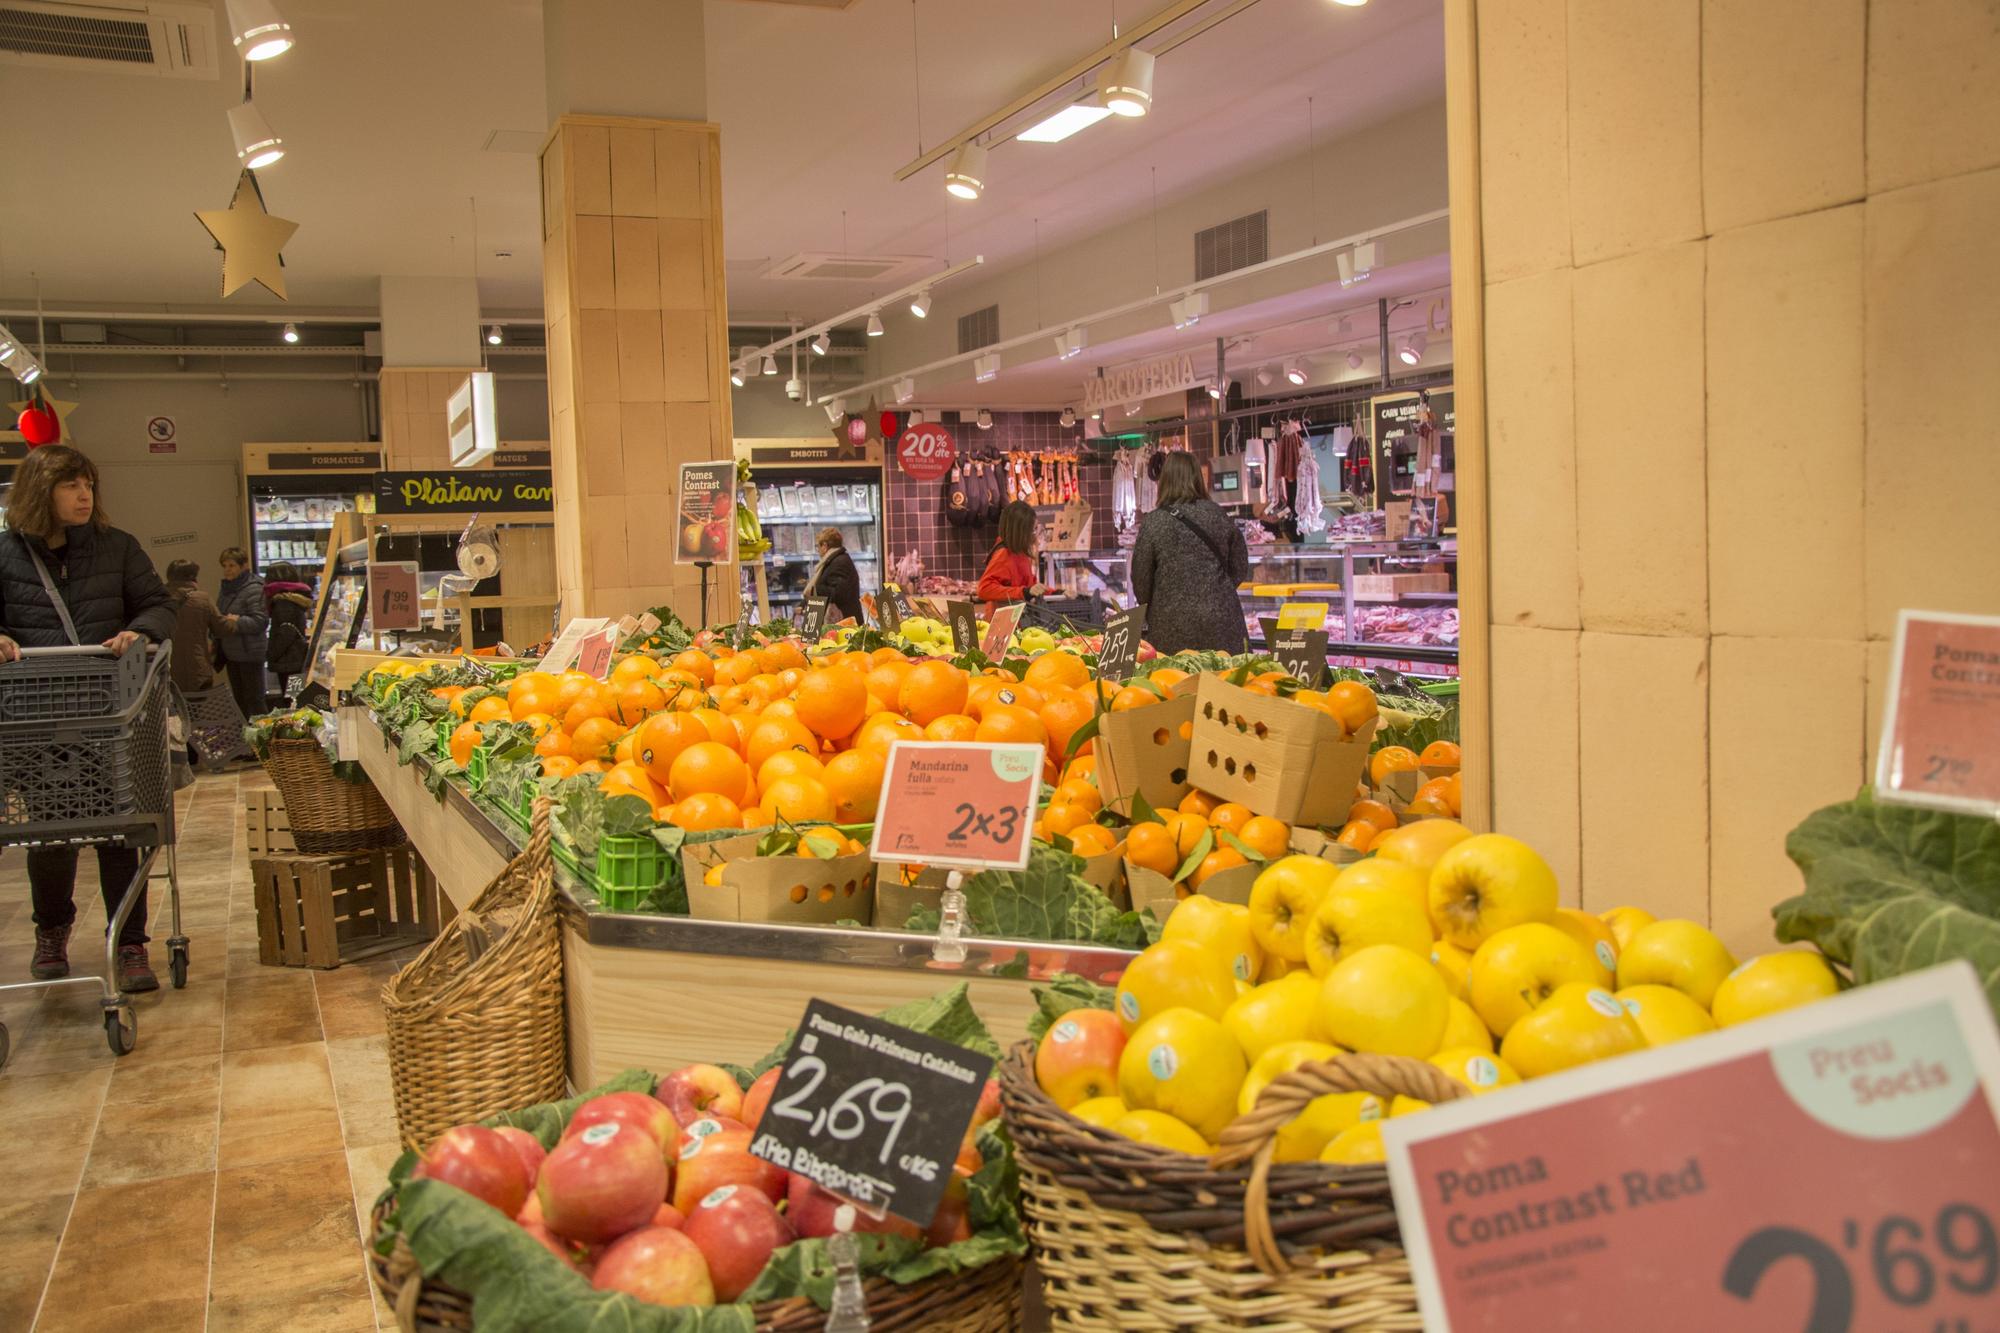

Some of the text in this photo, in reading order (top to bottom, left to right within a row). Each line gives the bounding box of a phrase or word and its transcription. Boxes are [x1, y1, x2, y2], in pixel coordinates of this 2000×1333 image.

[312, 456, 365, 465] FORMATGES
[790, 450, 828, 458] EMBOTITS
[684, 470, 713, 480] Pomes
[684, 480, 720, 490] Contrast
[400, 476, 503, 506] Plàtan
[1934, 643, 2000, 665] Poma
[907, 772, 932, 784] fulla
[910, 760, 969, 773] Mandarina
[809, 1012, 843, 1038] Poma
[842, 1024, 871, 1048] Gala
[1806, 1036, 1895, 1081] Preu
[1848, 1056, 1951, 1106] Socis
[771, 1055, 913, 1165] 2,69
[1435, 1154, 1550, 1206] Poma
[1444, 1156, 1709, 1250] Contrast Red
